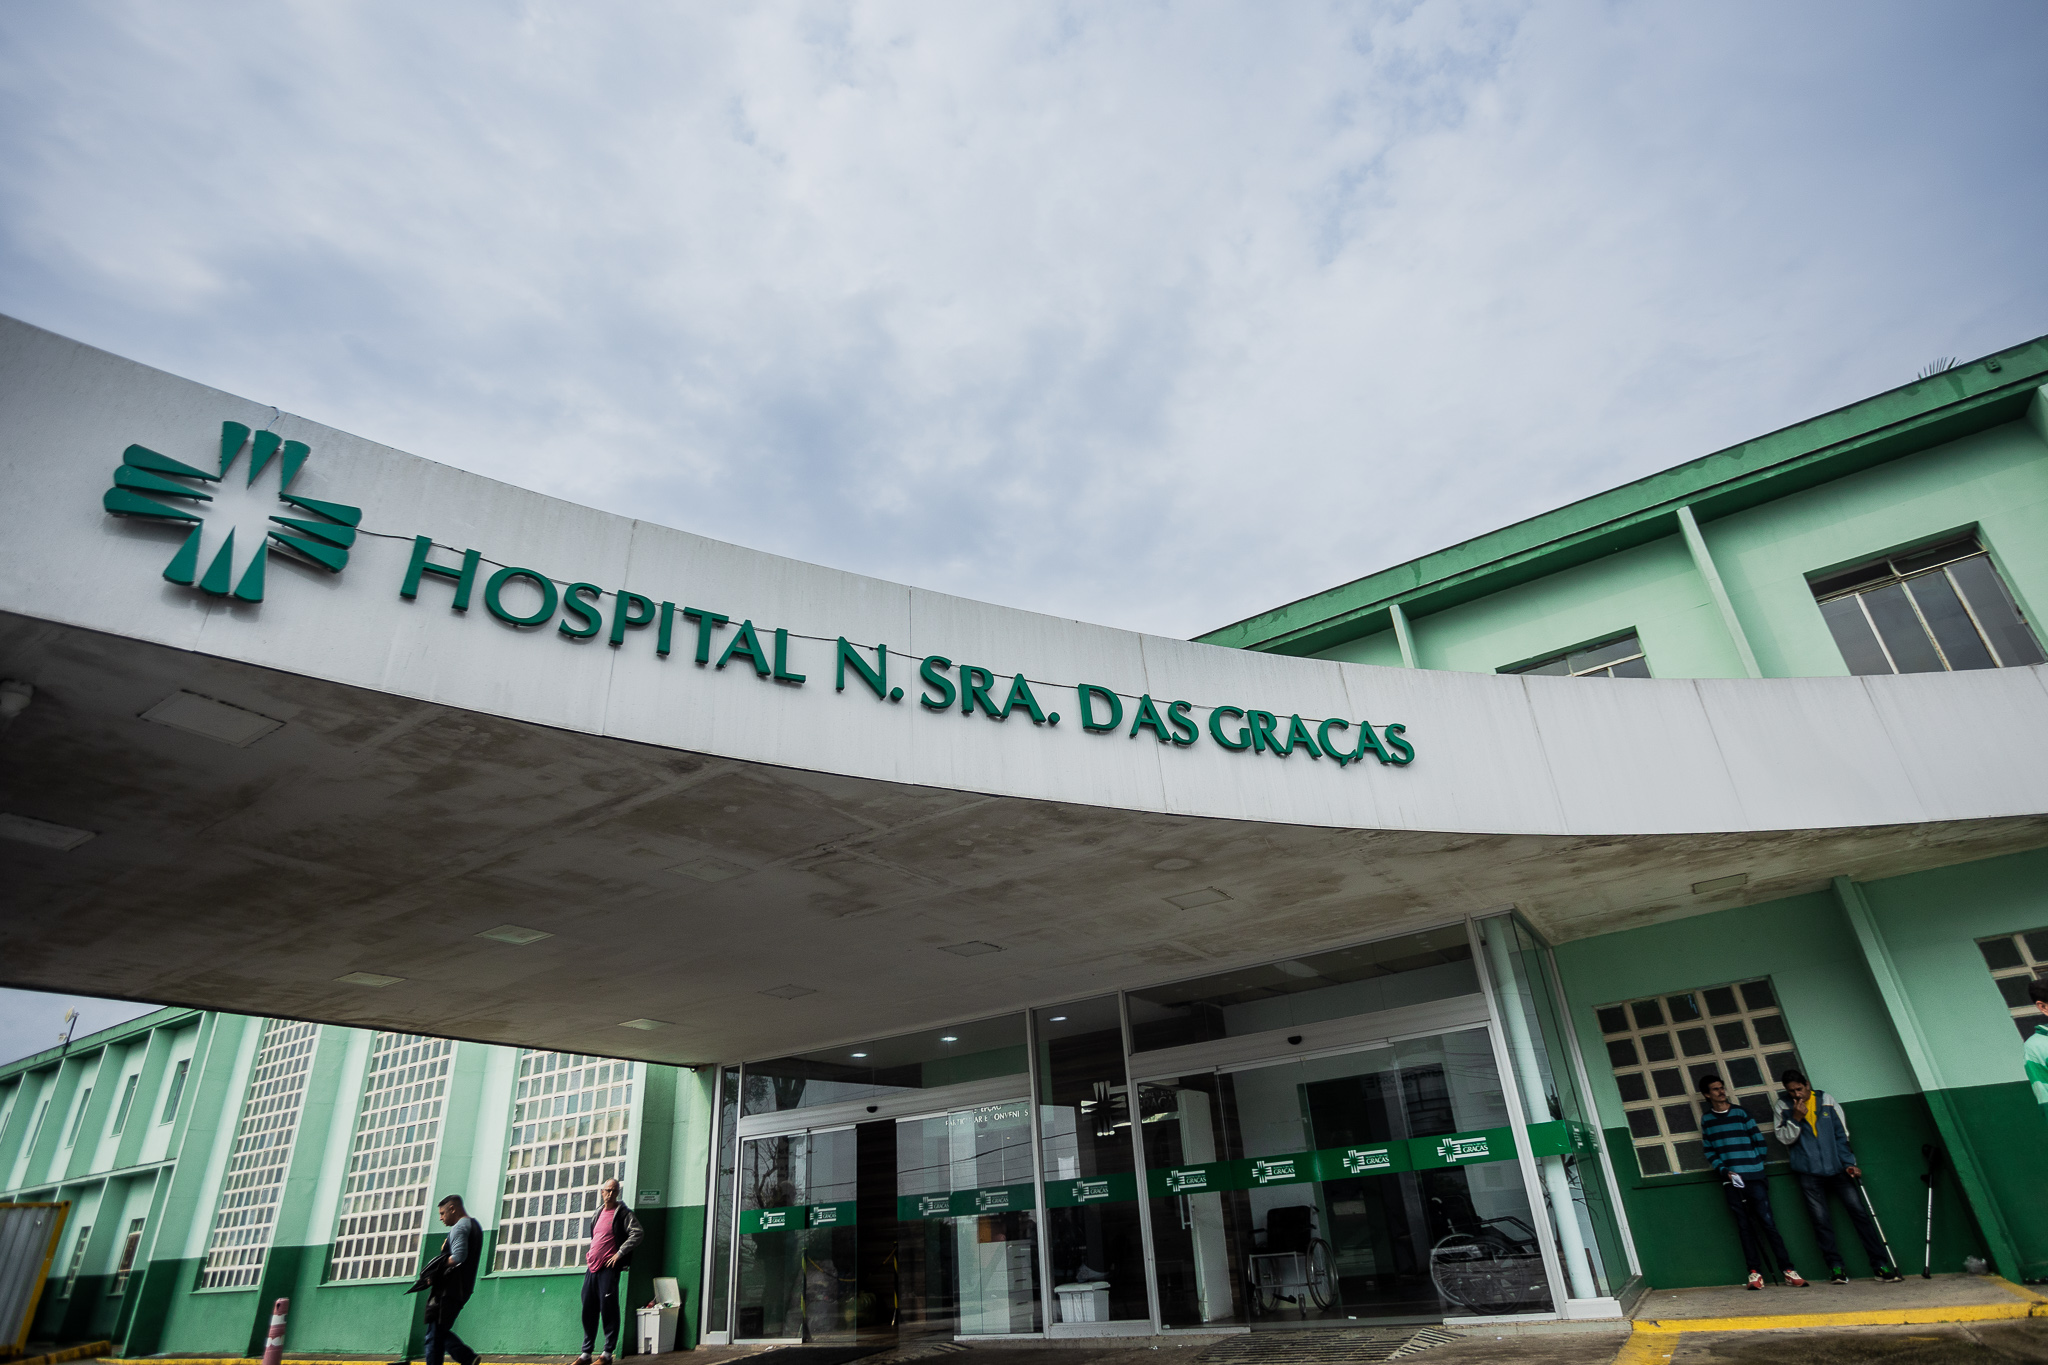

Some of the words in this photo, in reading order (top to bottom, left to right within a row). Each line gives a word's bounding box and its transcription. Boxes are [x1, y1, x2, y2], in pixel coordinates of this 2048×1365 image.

[400, 534, 806, 684] HOSPITAL
[837, 636, 905, 702] N.
[920, 655, 1061, 724] SRA.
[1077, 683, 1200, 746] DAS
[1209, 705, 1415, 767] GRAÇAS
